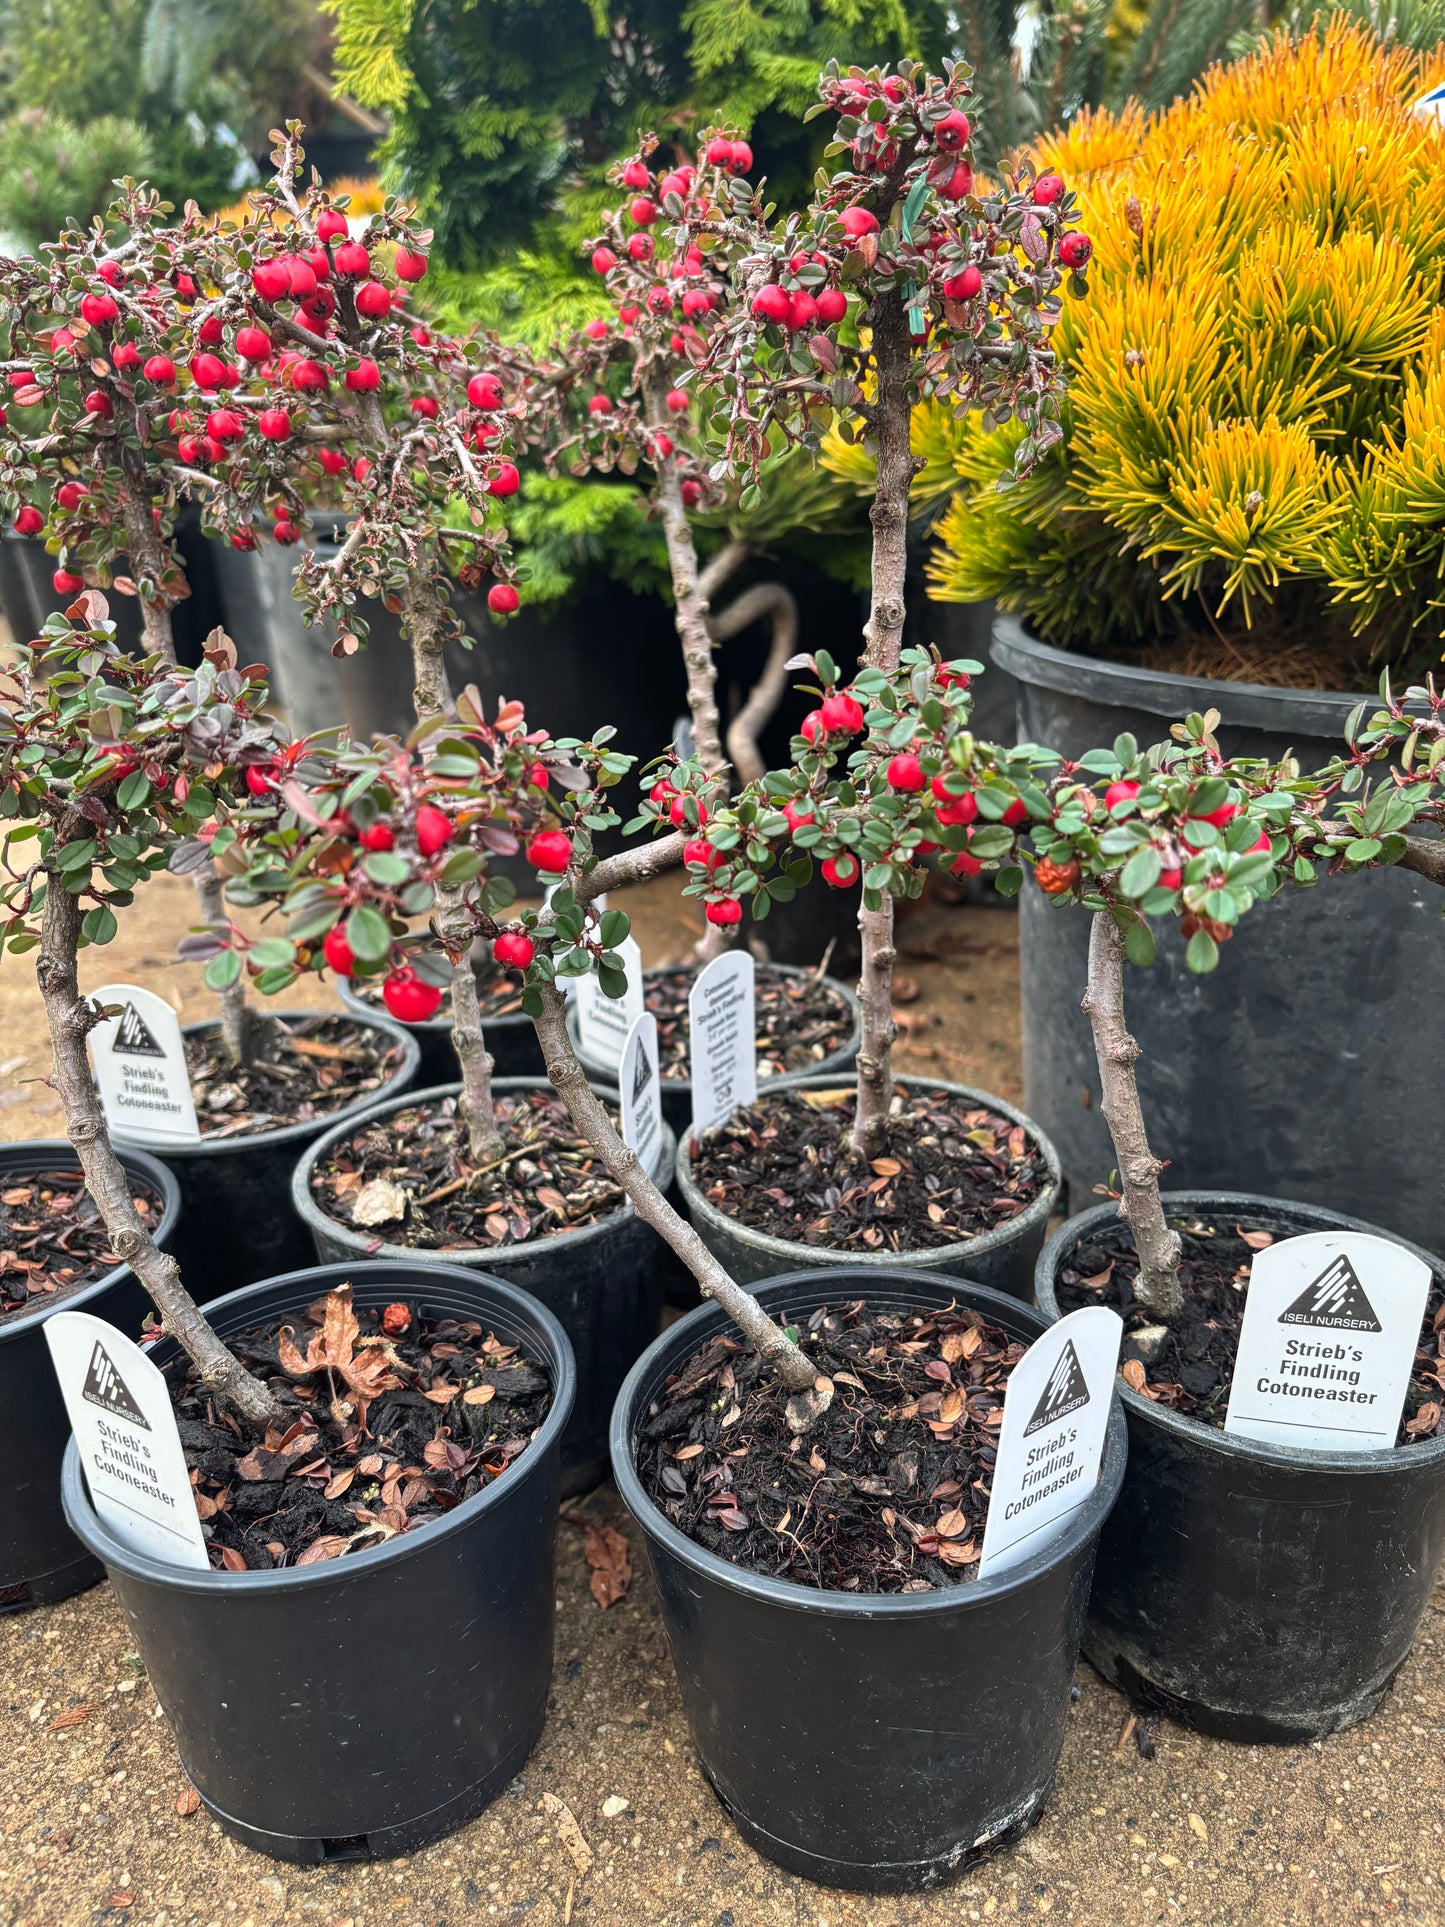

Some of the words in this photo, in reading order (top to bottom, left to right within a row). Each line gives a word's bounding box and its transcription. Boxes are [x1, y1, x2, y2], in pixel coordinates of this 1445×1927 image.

[122, 1064, 165, 1081] Strieb's
[124, 1080, 169, 1099] Findling
[117, 1093, 183, 1114] Cotoneaster
[1284, 1313, 1313, 1324] ISELI
[1316, 1316, 1377, 1330] NURSERY
[1286, 1339, 1363, 1361] Strieb's
[1280, 1359, 1361, 1385] Findling
[1256, 1378, 1378, 1405] Cotoneaster
[106, 1401, 147, 1426] NURSERY
[1026, 1415, 1047, 1434] ISELI
[1048, 1394, 1087, 1420] NURSERY
[97, 1419, 151, 1458] Strieb's
[1027, 1428, 1077, 1466] Strieb's
[101, 1439, 158, 1483] Findling
[1021, 1450, 1075, 1491] Findling
[94, 1453, 176, 1508] Cotoneaster
[1004, 1465, 1084, 1521] Cotoneaster
